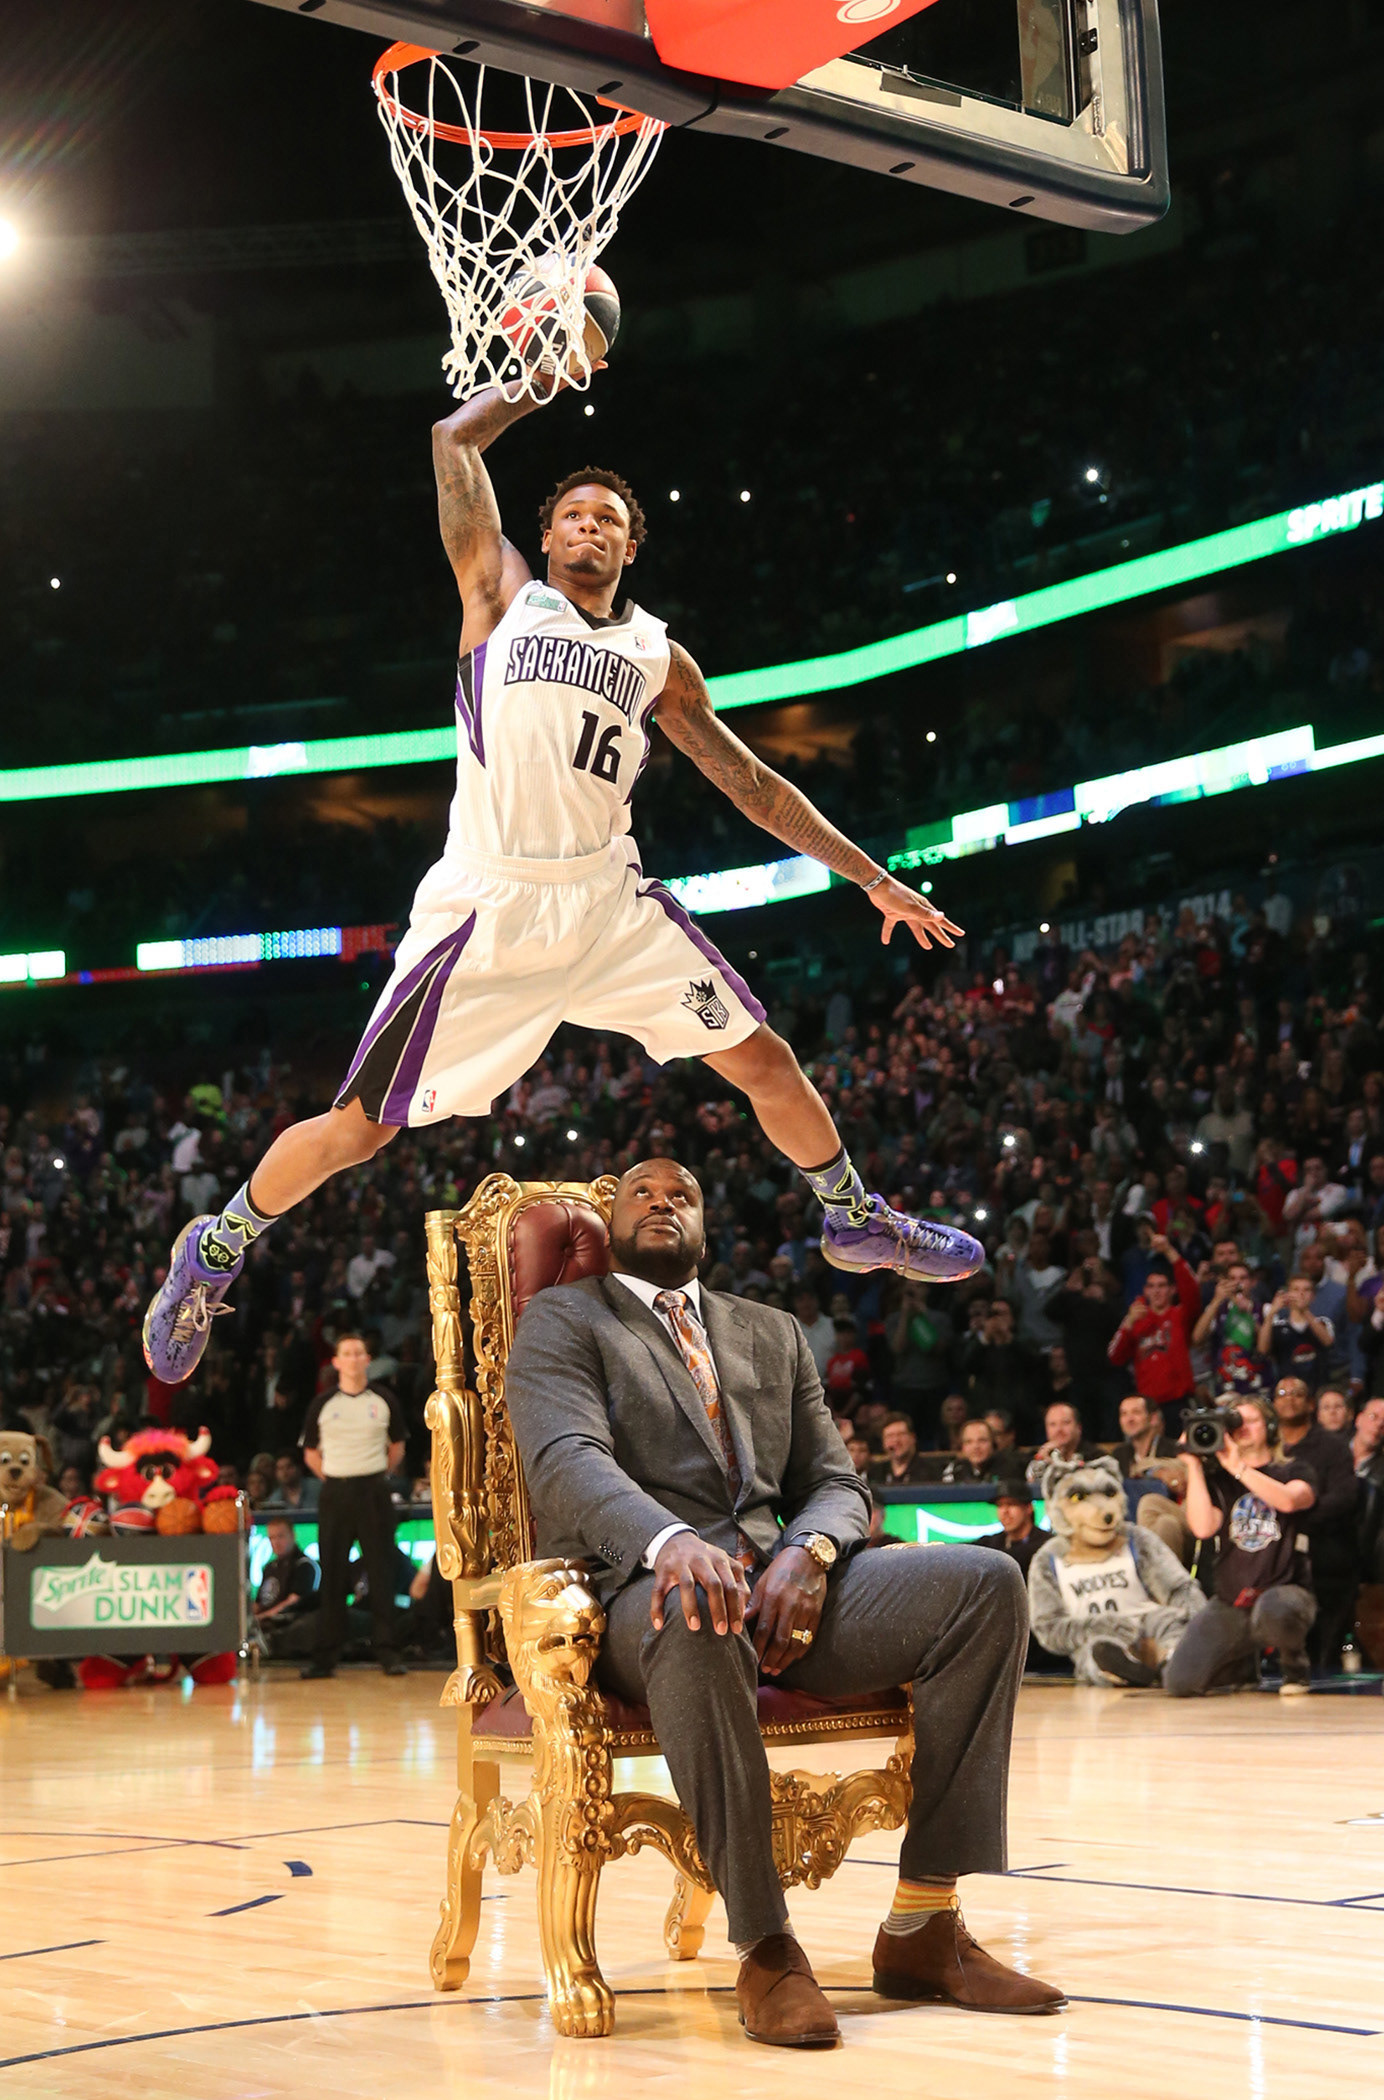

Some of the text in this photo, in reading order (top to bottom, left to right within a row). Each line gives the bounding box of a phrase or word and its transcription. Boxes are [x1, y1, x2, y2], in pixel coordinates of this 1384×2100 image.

[1286, 483, 1384, 542] SPRITE
[504, 635, 646, 727] SACRAMENTO
[572, 710, 622, 784] 16
[43, 1566, 183, 1602] Sprite SLAM
[1069, 1569, 1129, 1597] WOLVES
[94, 1596, 180, 1622] DUNK
